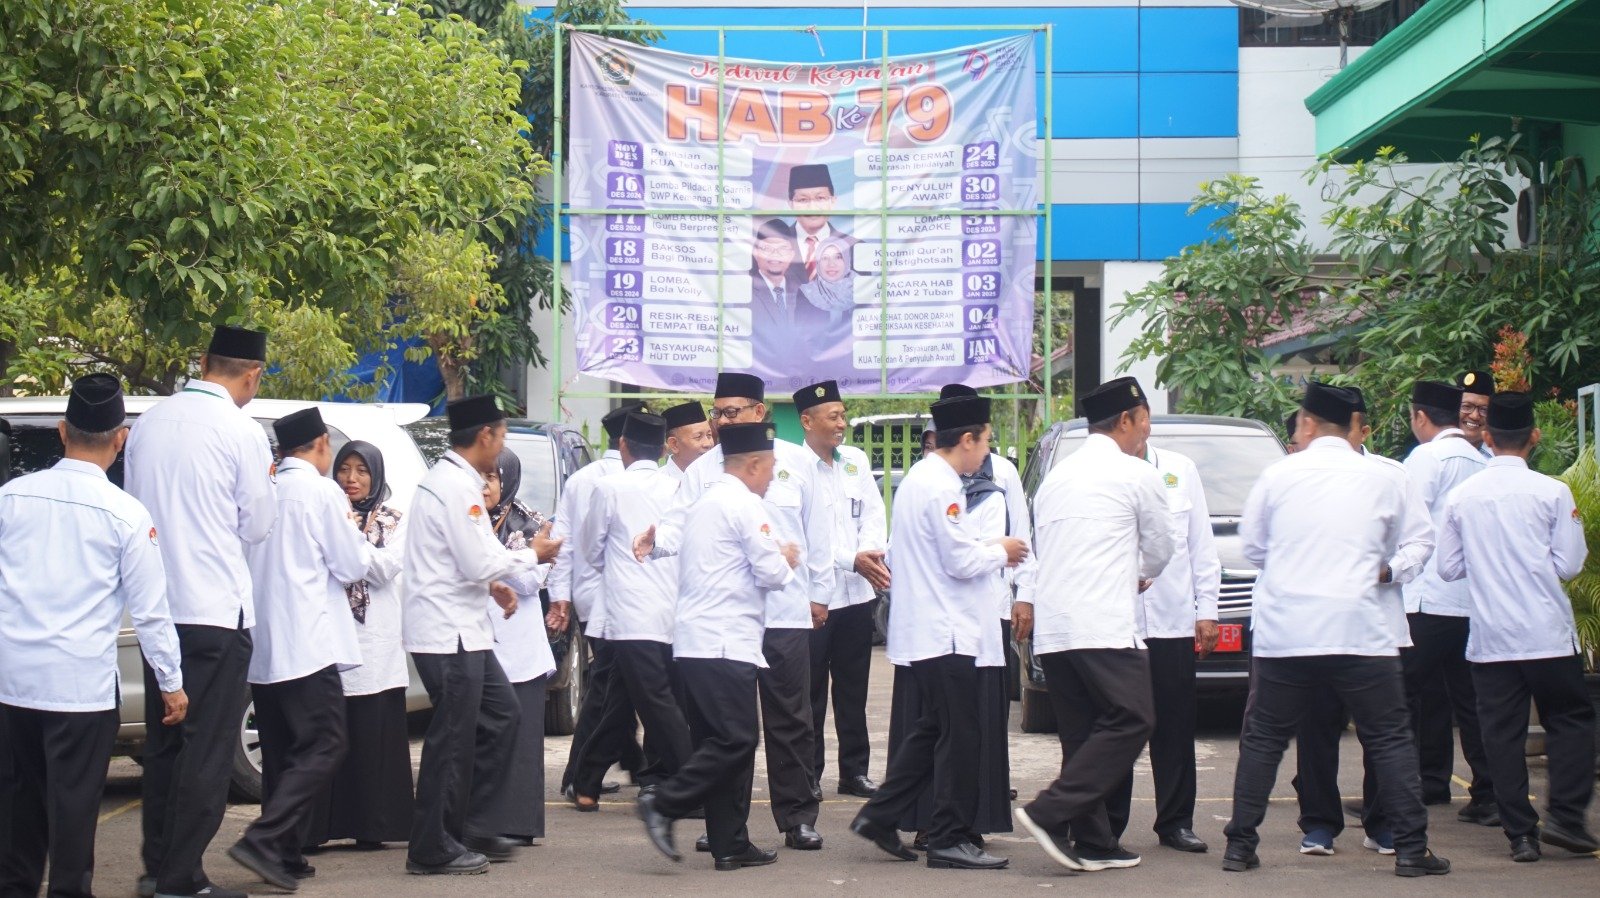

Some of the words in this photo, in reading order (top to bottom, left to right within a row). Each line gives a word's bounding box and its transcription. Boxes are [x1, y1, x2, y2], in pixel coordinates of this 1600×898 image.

[690, 61, 800, 83] Jadwal
[809, 61, 929, 85] Kegiatan
[666, 84, 834, 144] HAB
[836, 106, 865, 131] Ke
[856, 84, 952, 143] 79
[614, 143, 638, 153] NOV
[967, 144, 997, 162] 24
[614, 152, 638, 161] DES
[651, 148, 701, 160] Penilaian
[913, 151, 955, 160] CERMAT
[650, 159, 675, 167] KUA
[680, 160, 720, 171] Teladan
[615, 175, 638, 192] 16
[650, 180, 679, 190] Lomba
[722, 184, 752, 194] Garnis
[891, 182, 953, 192] PENYULUH
[965, 176, 996, 193] 30
[626, 191, 642, 199] 2024
[651, 191, 671, 200] DWP
[912, 193, 952, 201] AWARD
[914, 214, 952, 224] LOMBA
[625, 224, 642, 232] 2024
[652, 221, 677, 231] (Guru
[898, 223, 951, 233] KARAOKE
[613, 240, 637, 256] 18
[651, 243, 696, 254] BAKSOS
[917, 246, 953, 255] Qur'an
[967, 242, 997, 258] 02
[651, 253, 675, 263] Bagi
[677, 254, 714, 264] Dhuafa
[895, 256, 954, 267] Istighotsah
[613, 272, 636, 289] 19
[650, 276, 691, 285] LOMBA
[930, 279, 954, 287] HAB
[967, 274, 996, 291] 03
[624, 290, 640, 298] 2024
[650, 285, 674, 293] Bola
[677, 286, 702, 296] Volly
[887, 289, 911, 298] MAN
[914, 289, 920, 297] 2
[922, 289, 954, 297] Tuban
[612, 305, 638, 322] 20
[649, 312, 720, 322] RESIK-RESIK
[856, 313, 879, 322] JALAN
[904, 312, 929, 321] DONOR
[930, 311, 954, 320] DARAH
[968, 307, 994, 324] 04
[625, 322, 640, 330] 2024
[650, 321, 693, 331] TEMPAT
[914, 321, 954, 330] KESEHATAN
[612, 337, 639, 354] 23
[650, 342, 720, 353] TASYAKURAN
[968, 338, 996, 359] JAN
[649, 353, 671, 361] HUT
[672, 353, 697, 362] DWP
[898, 355, 904, 363] &
[905, 354, 934, 364] Penyuluh
[935, 353, 955, 362] Award
[1222, 626, 1240, 643] EP
